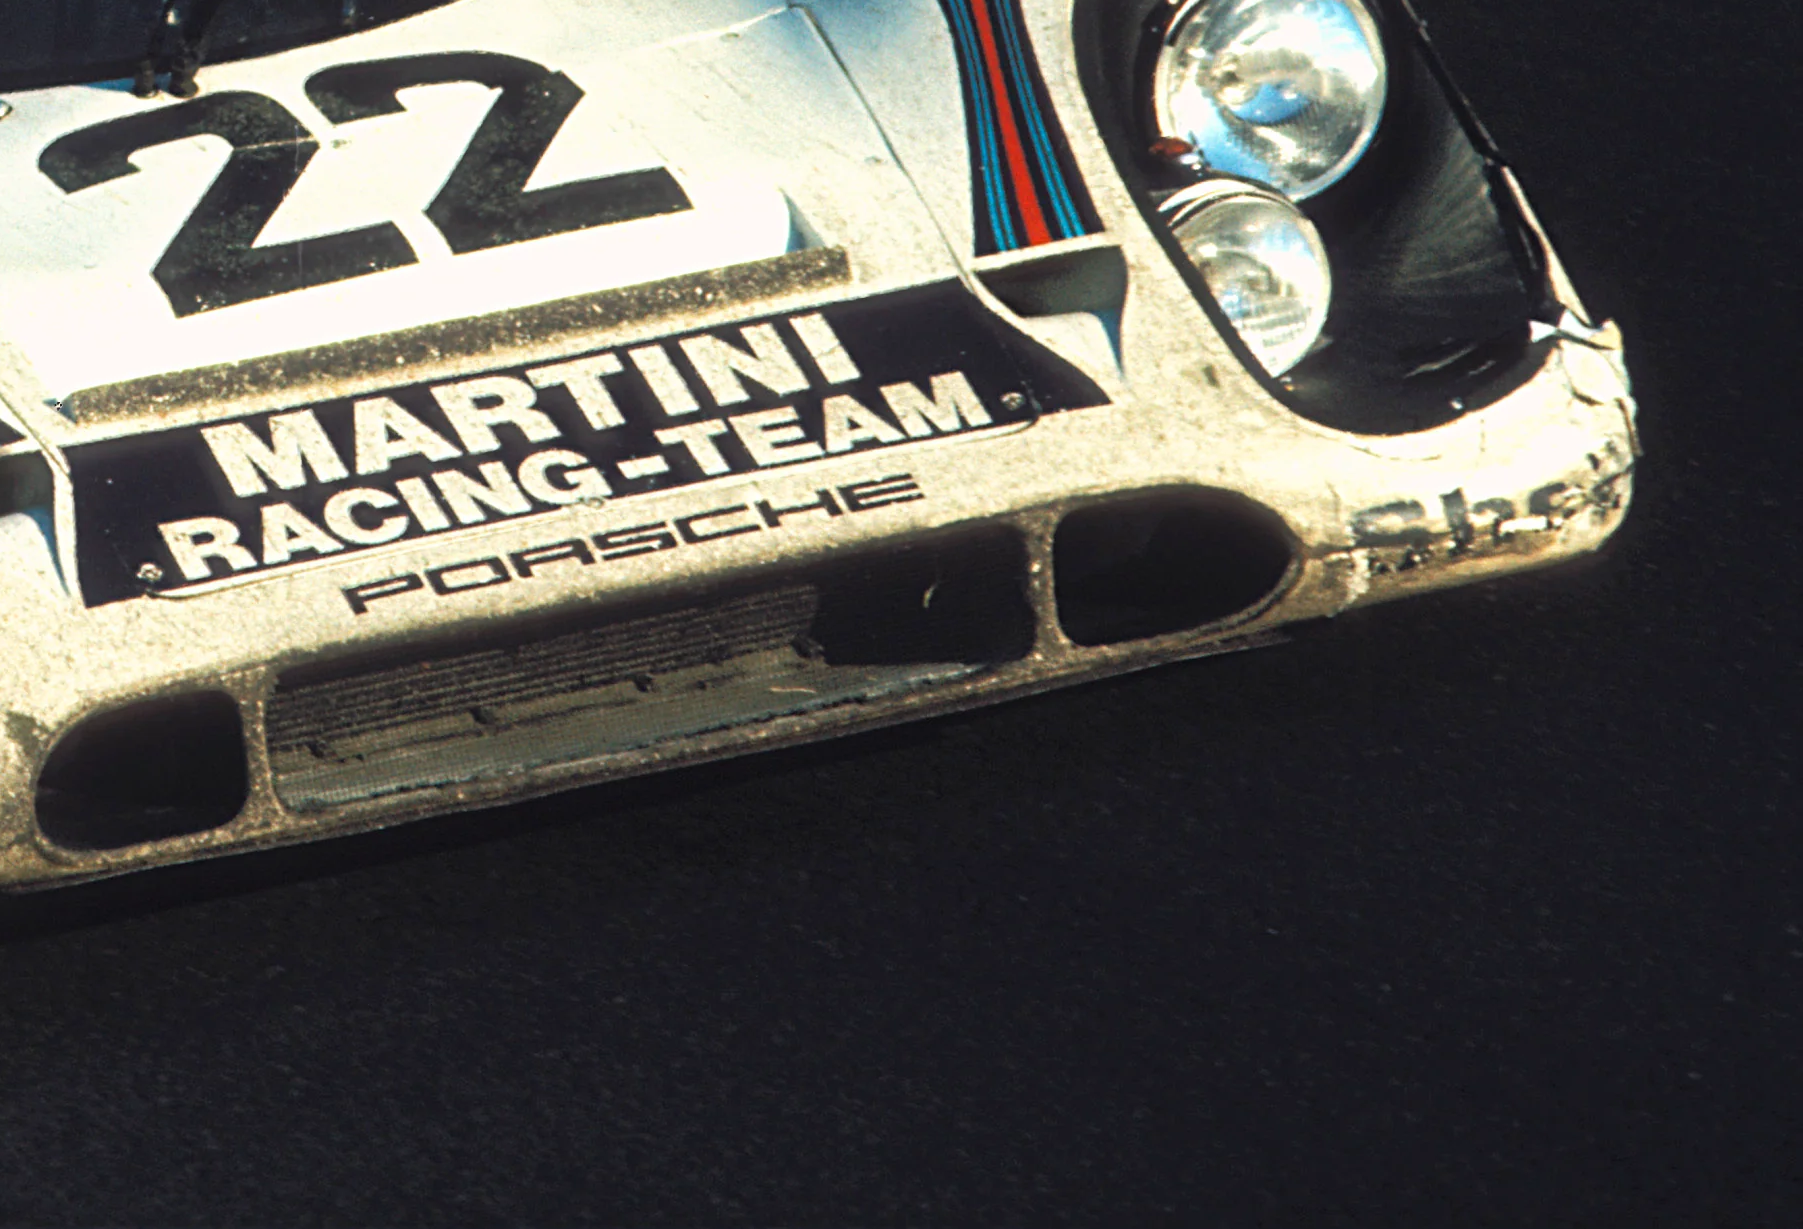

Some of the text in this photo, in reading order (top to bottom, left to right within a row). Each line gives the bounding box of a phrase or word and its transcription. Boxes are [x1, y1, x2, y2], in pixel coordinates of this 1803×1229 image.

[37, 49, 695, 319] 22
[155, 369, 995, 583] RACING-TEAM
[199, 312, 863, 500] MARTINI
[340, 470, 926, 615] PORSCHE
